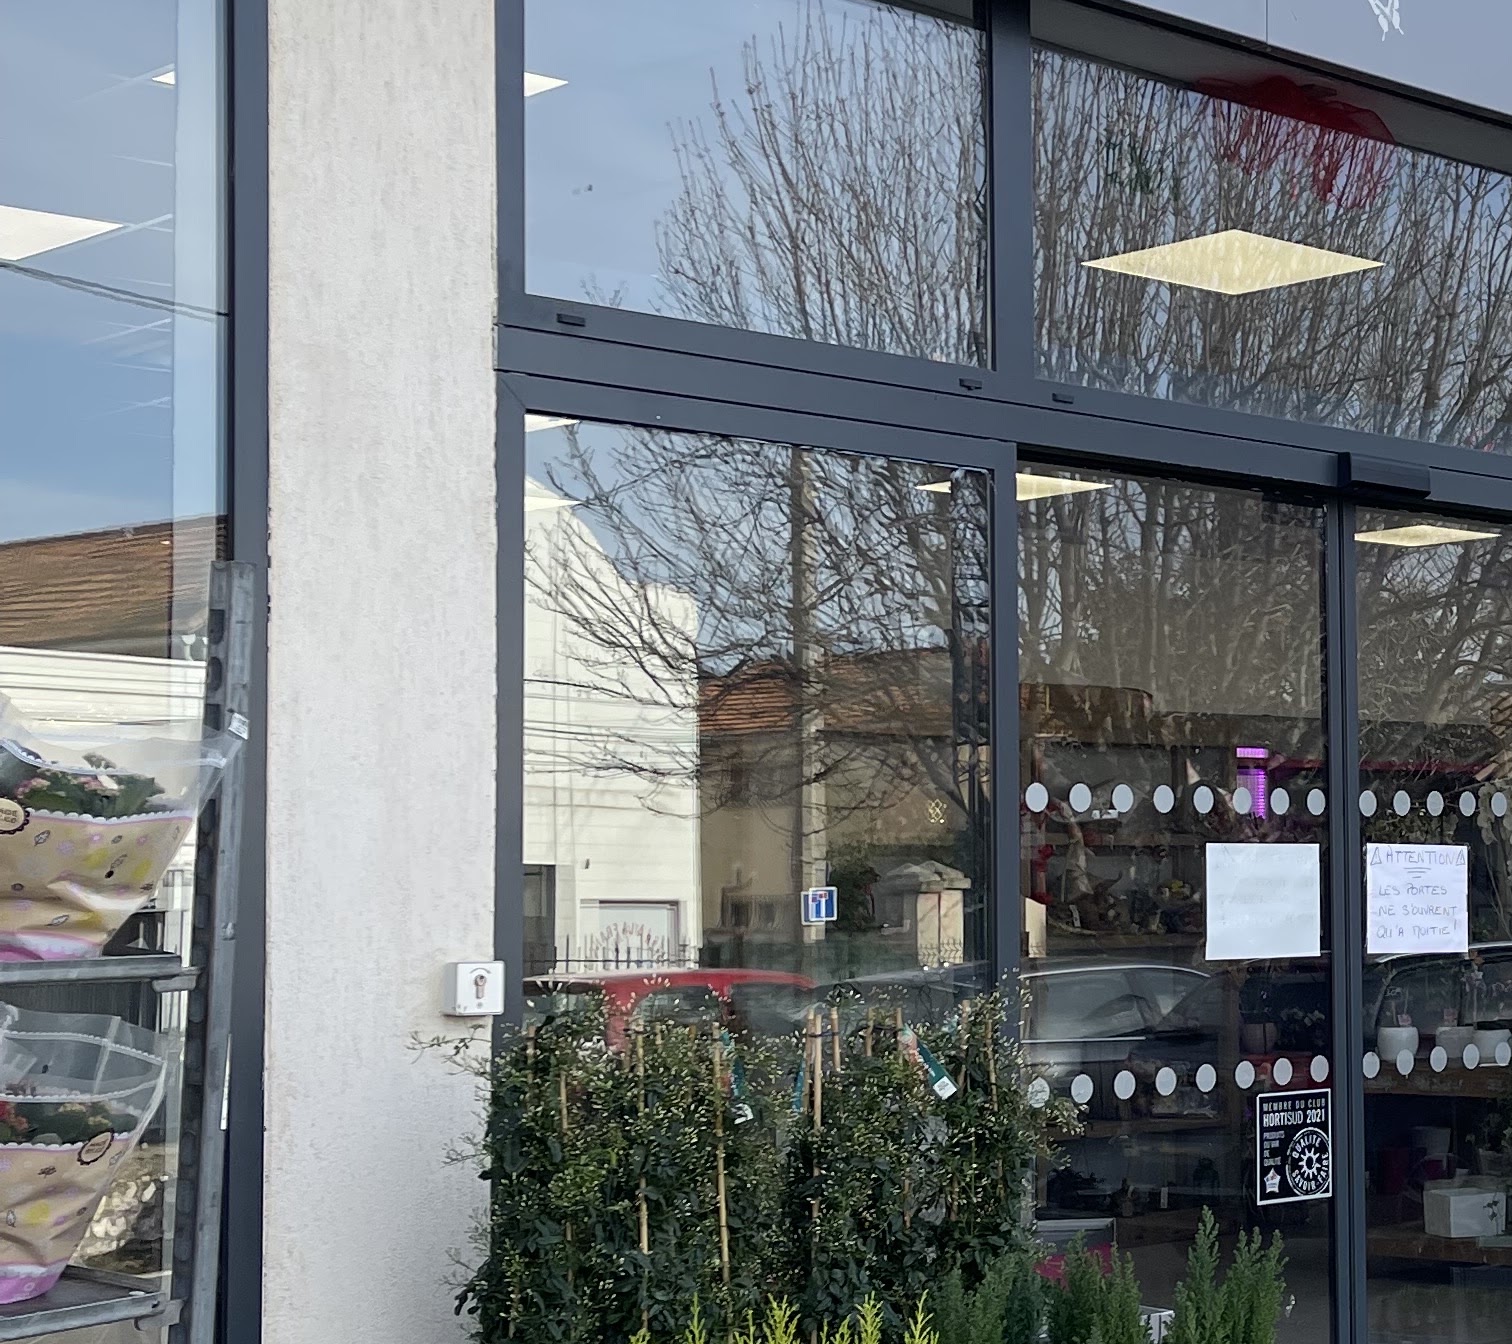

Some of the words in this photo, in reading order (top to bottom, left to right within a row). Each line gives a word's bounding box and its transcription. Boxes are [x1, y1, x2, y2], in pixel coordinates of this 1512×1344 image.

[1386, 845, 1454, 865] ATTENTION
[1378, 885, 1400, 896] LES
[1406, 883, 1447, 896] PORTES
[1378, 904, 1395, 916] NE
[1402, 904, 1457, 916] S'OUVRENT
[1263, 1101, 1292, 1112] MEMBRE
[1295, 1099, 1305, 1109] DU
[1308, 1098, 1325, 1108] CLUB
[1263, 1111, 1303, 1127] HORTISUD
[1307, 1109, 1325, 1123] 2021
[1292, 1152, 1328, 1191] SAVOIR-FAIRE
